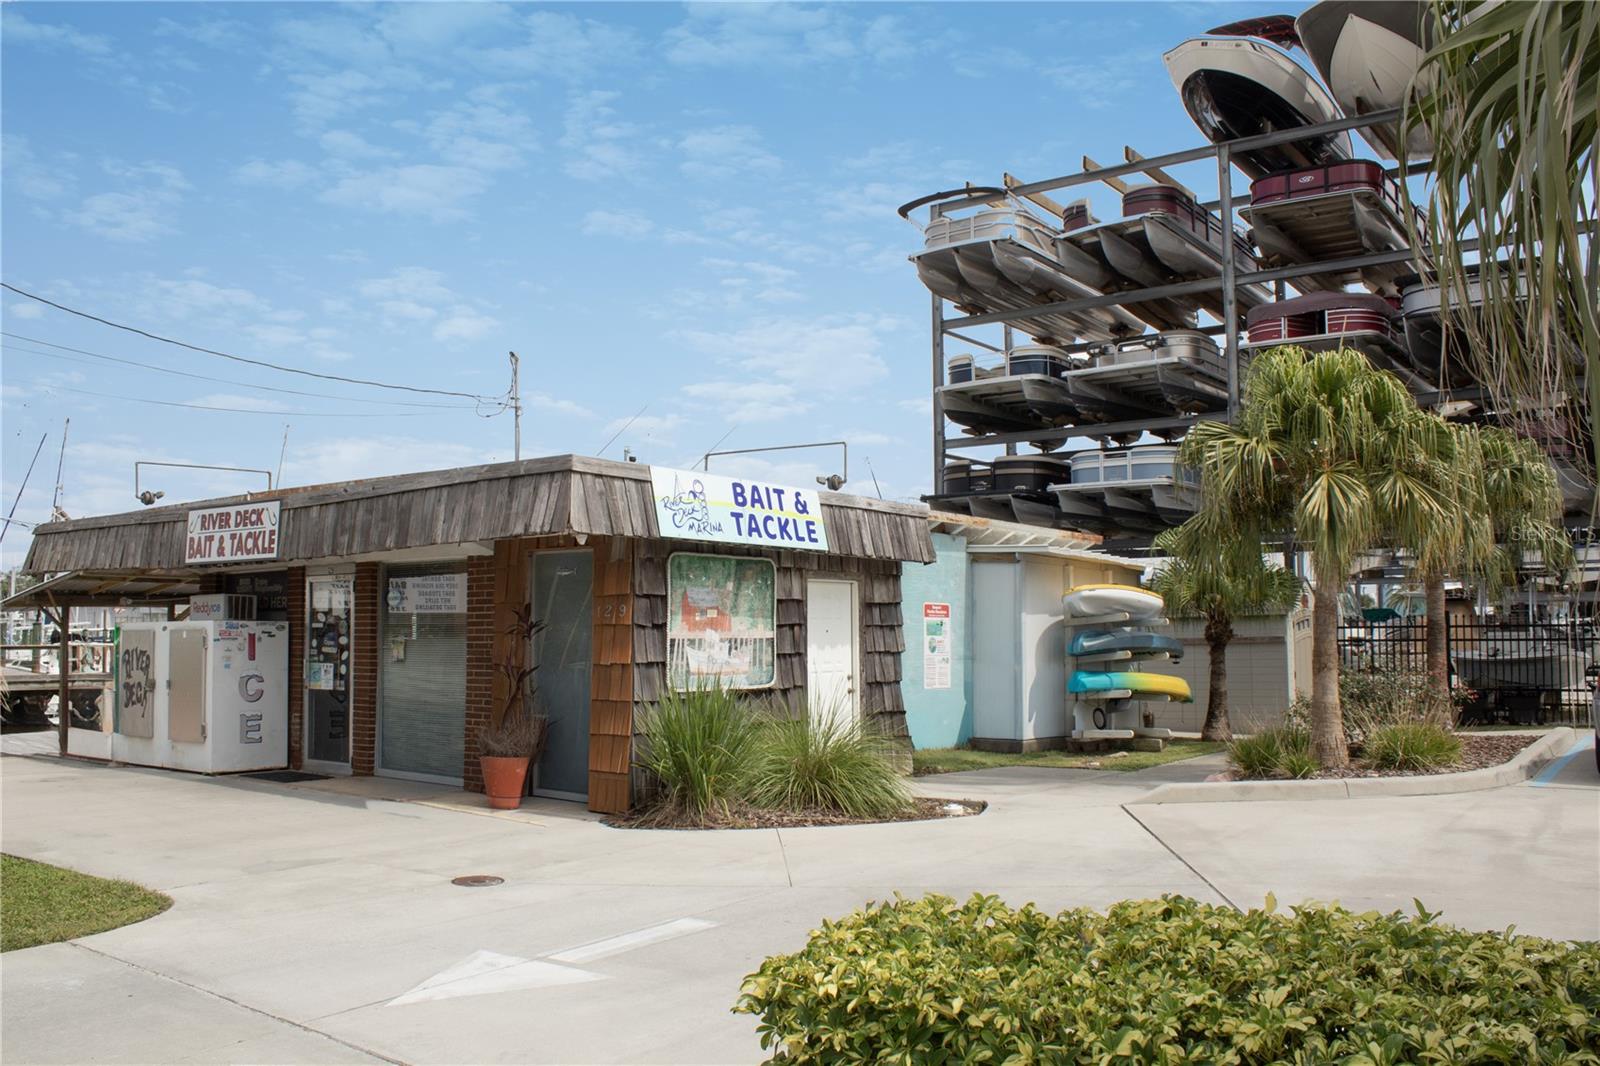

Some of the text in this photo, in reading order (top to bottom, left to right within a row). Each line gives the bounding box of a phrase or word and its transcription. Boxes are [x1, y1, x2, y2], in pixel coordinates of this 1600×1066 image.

[731, 482, 809, 515] BAIT &
[200, 508, 264, 531] RIVER DECK
[688, 519, 724, 536] MARINA
[730, 512, 819, 543] TACKLE
[188, 530, 276, 559] BAIT & TACKLE
[122, 646, 151, 686] RIVER
[123, 682, 148, 718] DECK
[238, 632, 265, 745] ICE
